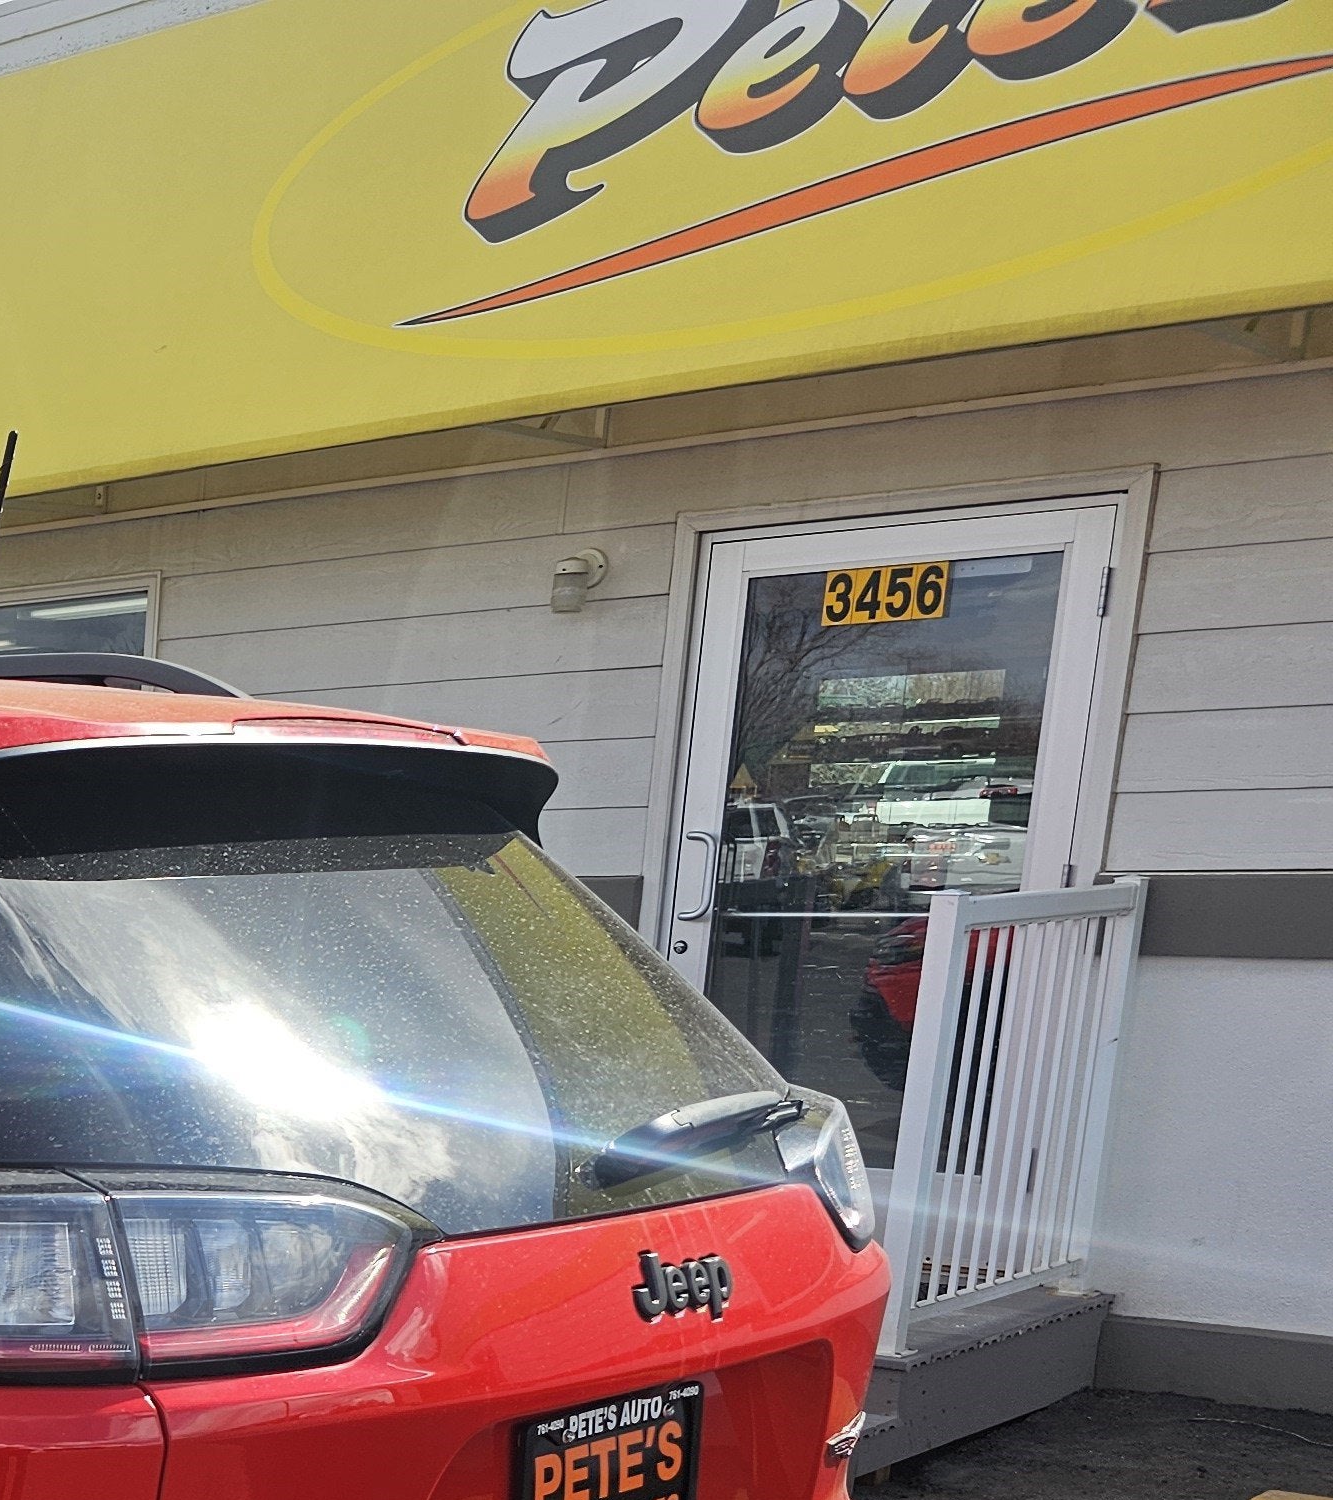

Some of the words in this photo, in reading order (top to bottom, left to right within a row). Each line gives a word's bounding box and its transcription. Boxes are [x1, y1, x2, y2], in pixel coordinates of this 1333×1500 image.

[826, 565, 943, 622] 3456
[631, 1250, 733, 1324] Jeep
[569, 1405, 618, 1439] PETE'S
[620, 1396, 663, 1427] AUTO
[669, 1386, 699, 1400] 761-4090
